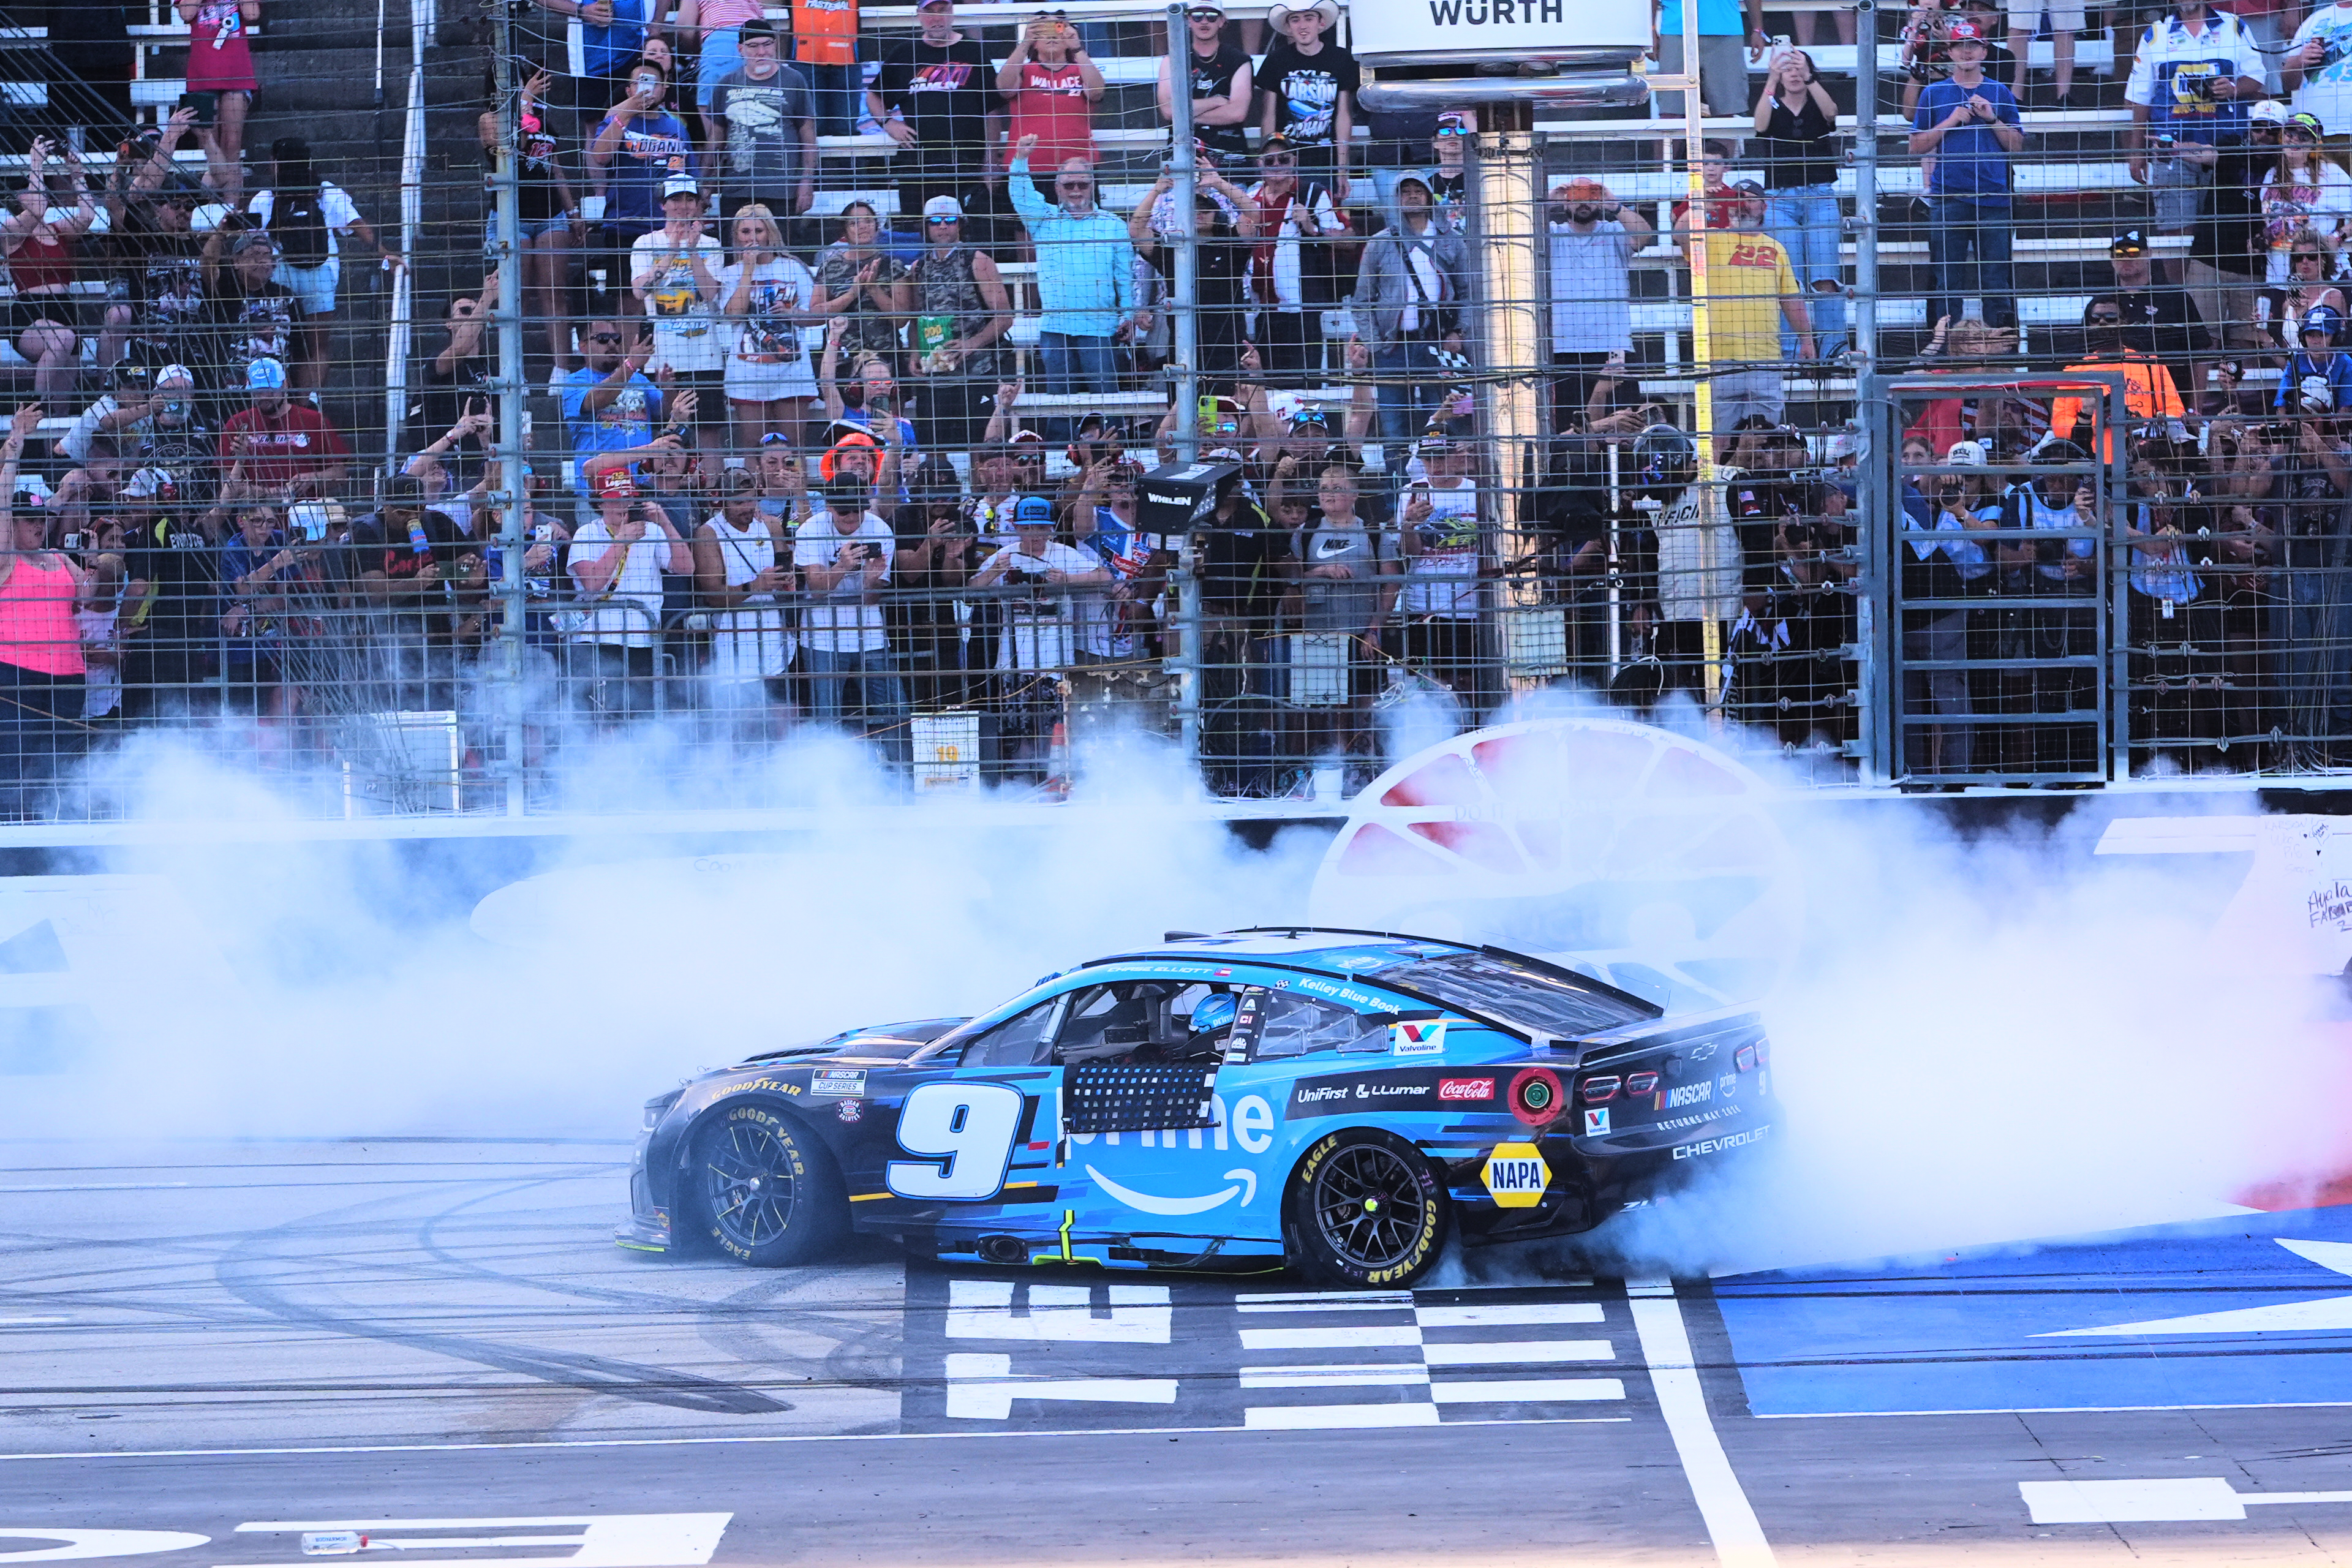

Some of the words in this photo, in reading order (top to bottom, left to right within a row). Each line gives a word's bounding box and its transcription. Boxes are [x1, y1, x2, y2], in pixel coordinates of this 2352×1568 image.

[1430, 0, 1562, 26] WÜRTH
[1031, 75, 1083, 89] WALLACE
[1280, 81, 1338, 102] LARSON
[1729, 244, 1779, 270] 22
[1147, 492, 1192, 506] WHELEN
[1322, 539, 1350, 549] NIKE
[935, 745, 958, 765] 19
[1298, 978, 1340, 997] Kelley
[1339, 988, 1368, 1004] Blue
[1368, 997, 1402, 1016] Book
[1212, 1013, 1234, 1027] prime
[1239, 1015, 1253, 1024] CI
[1400, 1044, 1437, 1052] Valvoline
[711, 1077, 802, 1101] GOODYEAR
[1297, 1087, 1349, 1103] UniFirst
[1439, 1080, 1490, 1099] Coca-Cola
[1719, 1072, 1736, 1088] prime
[1758, 1071, 1767, 1096] 9
[839, 1099, 860, 1108] NASCAR
[1669, 1080, 1712, 1108] NASCAR
[1656, 1114, 1702, 1132] RETURNS
[1703, 1109, 1722, 1122] MAY
[887, 1081, 1025, 1200] 9
[1672, 1125, 1770, 1160] CHEVROLET
[1302, 1134, 1338, 1184] EAGLE
[1493, 1161, 1540, 1189] NAPA
[710, 1226, 751, 1261] EAGLE
[1367, 1199, 1437, 1283] GOODYEAR
